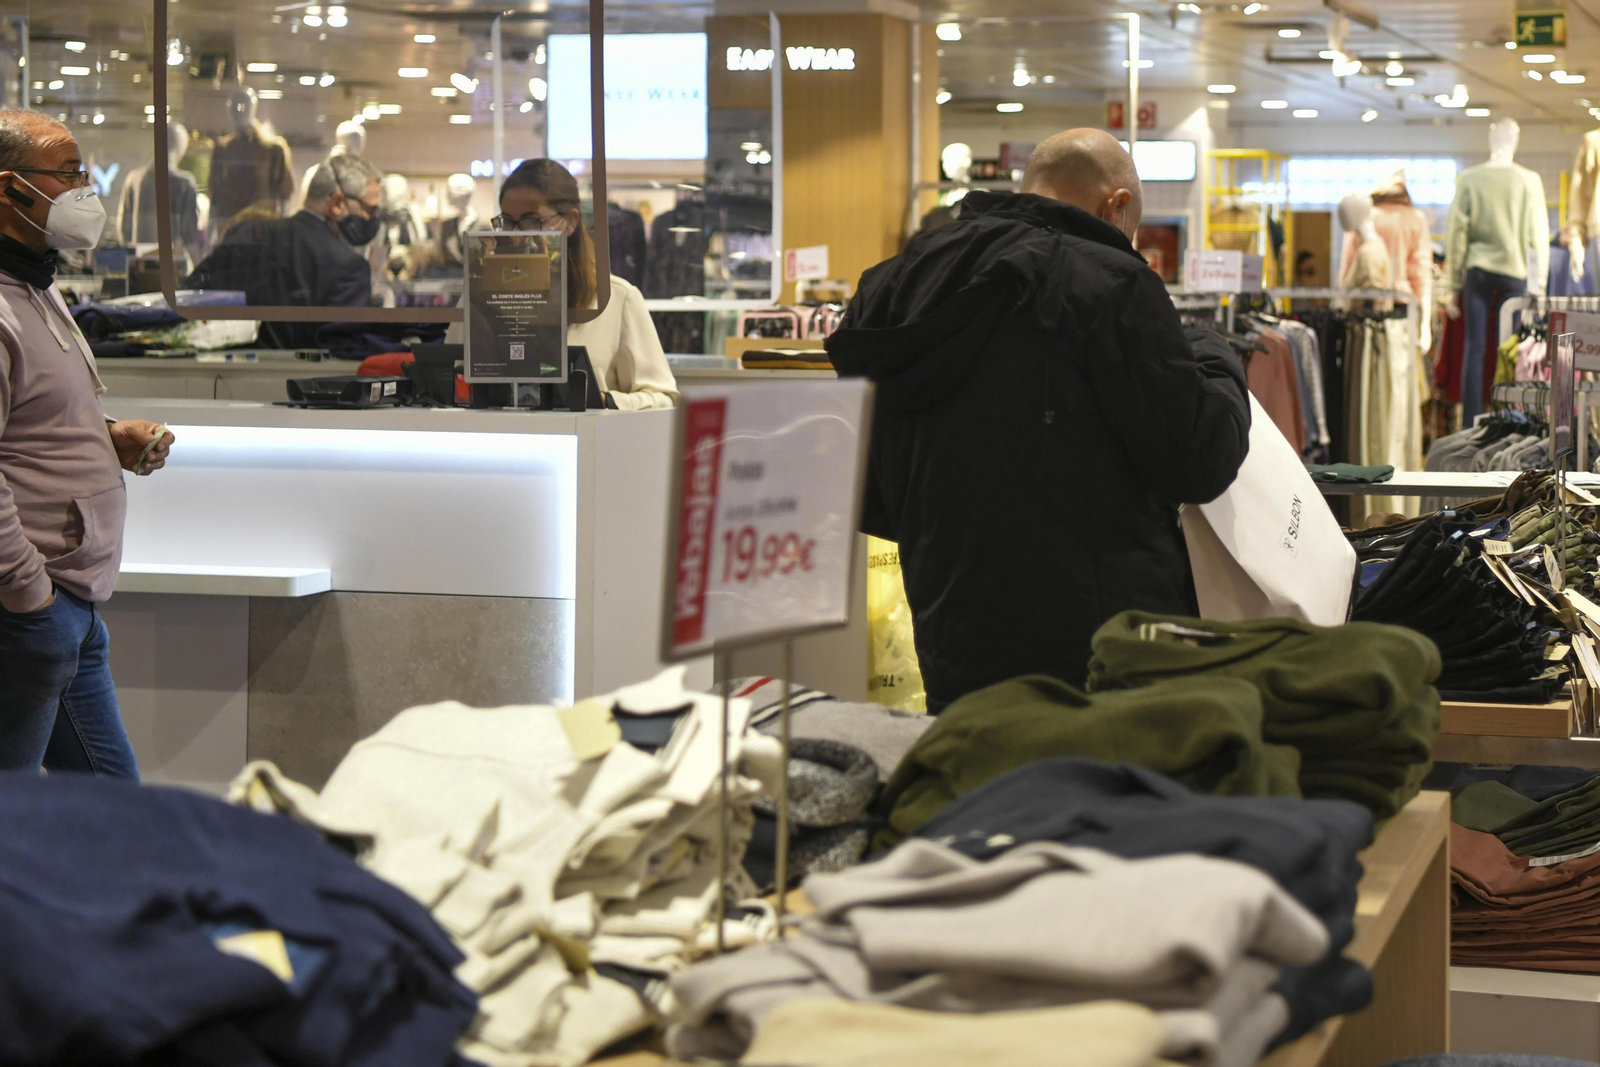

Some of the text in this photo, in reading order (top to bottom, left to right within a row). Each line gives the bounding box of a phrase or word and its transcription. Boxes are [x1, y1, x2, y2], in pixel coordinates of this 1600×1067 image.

[785, 46, 856, 71] WEAR
[674, 434, 720, 618] rebajas
[1288, 493, 1302, 540] SILBON
